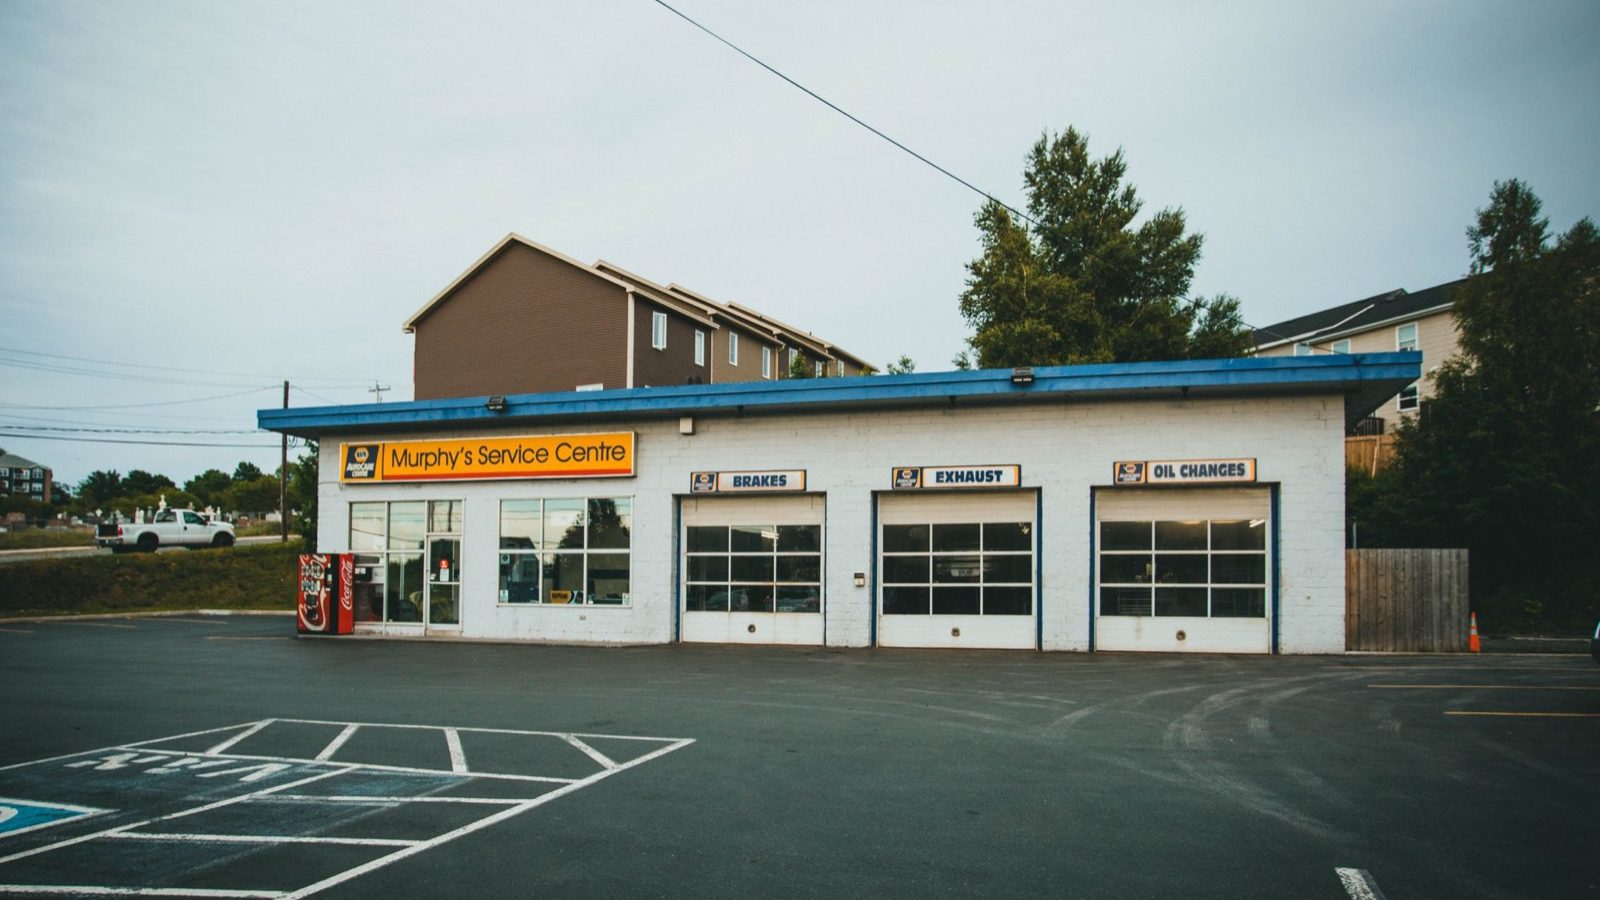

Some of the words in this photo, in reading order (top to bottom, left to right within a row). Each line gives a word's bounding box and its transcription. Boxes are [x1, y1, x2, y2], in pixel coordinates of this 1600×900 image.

[391, 447, 473, 471] Murphy's
[478, 444, 549, 465] Service
[555, 441, 626, 463] Centre
[935, 470, 1003, 484] EXHAUST
[1153, 464, 1176, 478] OIL
[1179, 463, 1246, 478] CHANGES
[733, 474, 787, 488] BRAKES
